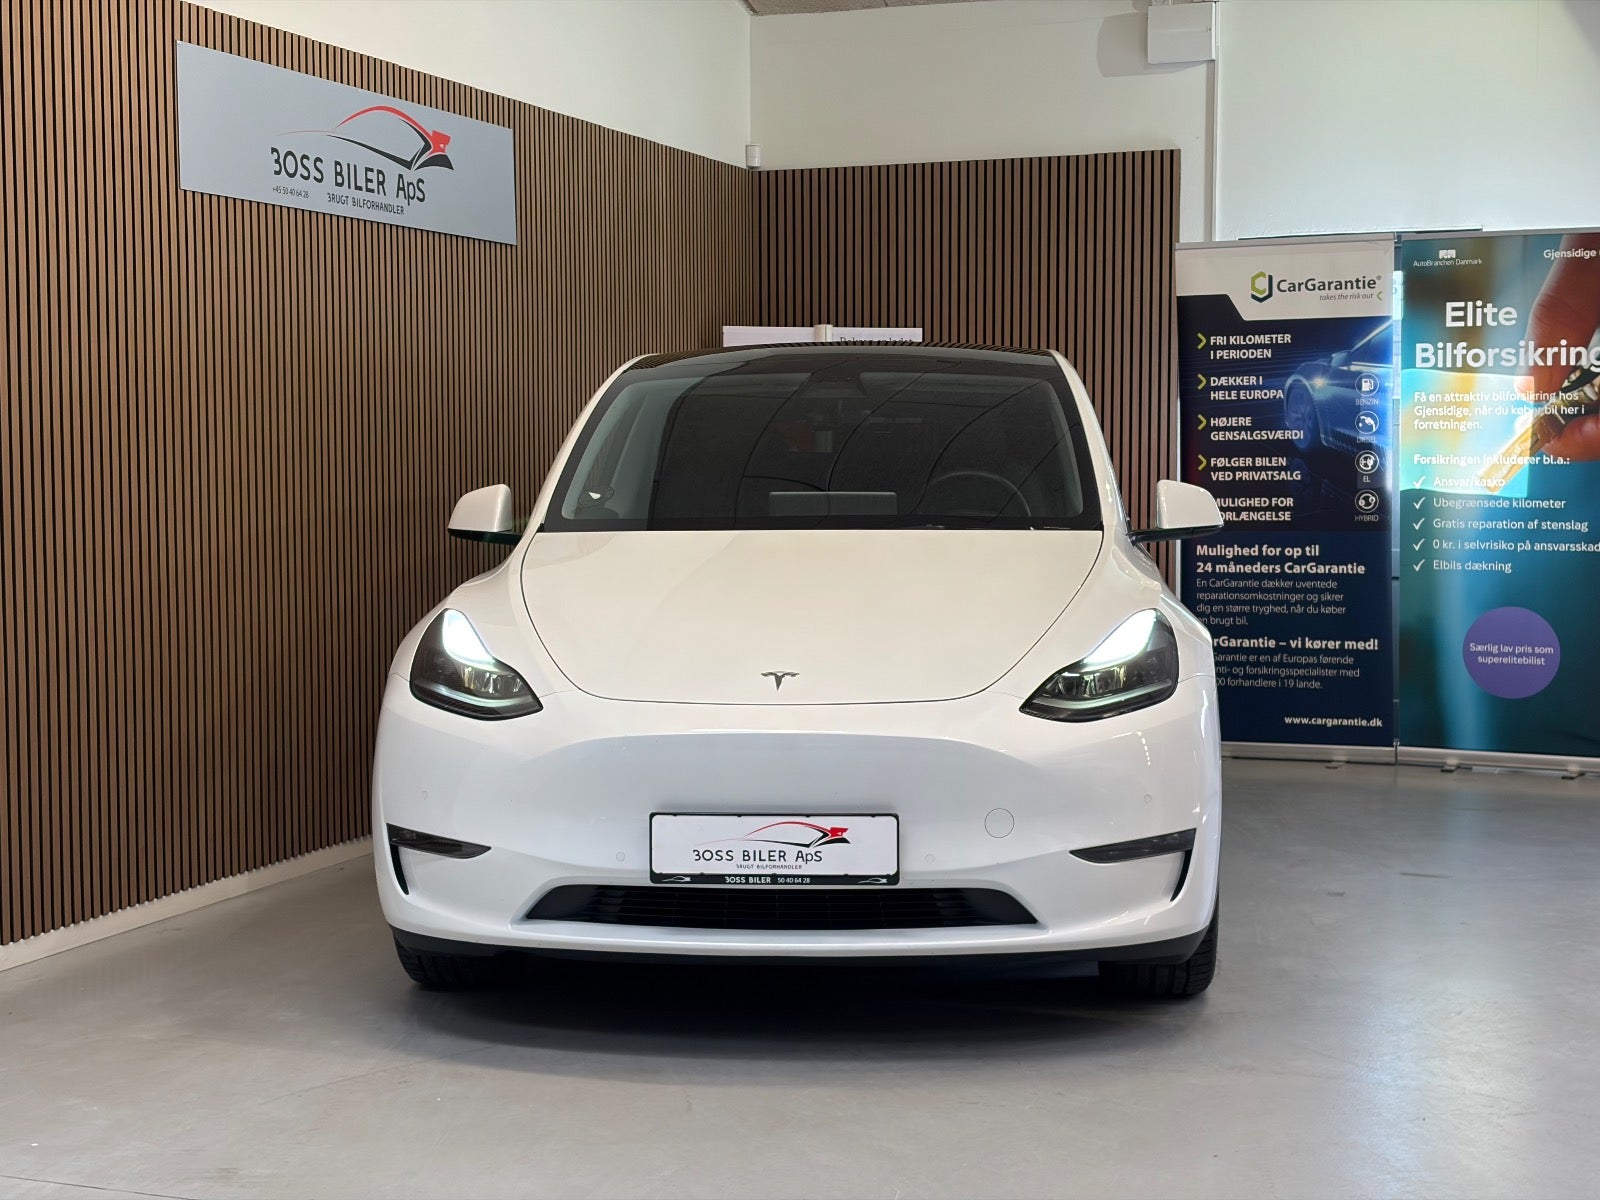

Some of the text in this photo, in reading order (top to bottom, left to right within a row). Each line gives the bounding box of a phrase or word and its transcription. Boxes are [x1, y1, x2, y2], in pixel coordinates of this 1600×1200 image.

[334, 160, 387, 196] BILER
[396, 173, 426, 206] ApS
[352, 197, 405, 215] BILFORHANDLER
[1543, 248, 1597, 260] Gjensidige
[1349, 292, 1361, 300] risk
[1445, 300, 1518, 328] Elite
[1210, 334, 1292, 346] FRI KILOMETER
[1216, 349, 1272, 360] PERIODEN
[1210, 376, 1257, 387] DÆKKER
[1210, 389, 1284, 401] HELE EUROPA
[1414, 391, 1426, 401] Få
[1444, 391, 1490, 401] attraktiv
[1492, 390, 1556, 402] bilforsikring
[1559, 391, 1579, 400] hos
[1414, 405, 1472, 418] Gjensidige,
[1475, 405, 1492, 415] når
[1495, 405, 1508, 415] du
[1544, 405, 1557, 415] bil
[1560, 405, 1580, 415] her
[1210, 417, 1252, 428] HØJERE
[1414, 419, 1483, 431] forretningen.
[1210, 430, 1304, 441] GENSALGSVÆRDI
[1210, 457, 1287, 468] FØLGER BILEN
[1414, 454, 1481, 465] Forsikringen
[1483, 454, 1540, 464] inkluderer
[1210, 471, 1301, 481] VED PRIVATSALG
[1363, 475, 1371, 483] EL
[1433, 476, 1505, 488] Ansvar/kasko
[1272, 498, 1294, 507] FOR
[1433, 497, 1566, 510] Ubegrænsede kilometer
[1220, 511, 1292, 521] RLÆNGELSE
[1355, 514, 1379, 522] HYBRID
[1433, 518, 1589, 532] Gratis reparation af stenslag
[1196, 544, 1320, 559] Mulighed for op til
[1432, 539, 1440, 549] 0
[1442, 539, 1456, 549] kr.
[1464, 540, 1514, 550] selvrisiko
[1517, 540, 1531, 552] på
[1534, 541, 1600, 552] ansvarsskad
[1196, 562, 1366, 575] 24 måneders CarGarantie
[1433, 559, 1512, 573] Elbils dækning
[1196, 579, 1338, 589] En CarGarantie dækker uventede
[1196, 591, 1344, 602] reparationsomkostninger og sikrer
[1196, 603, 1346, 615] dig en større tryghed, når du køber
[1210, 616, 1234, 626] brugt
[1213, 636, 1276, 648] rGarantie
[1290, 637, 1302, 648] vi
[1305, 637, 1341, 649] kører
[1344, 638, 1378, 650] med!
[1469, 642, 1554, 654] Særlig lav pris som
[1260, 655, 1270, 663] en
[1272, 653, 1282, 663] af
[1283, 654, 1318, 664] Europas
[1319, 655, 1354, 664] førende
[1477, 655, 1546, 665] superelitebilist
[1232, 667, 1244, 675] og
[1246, 665, 1338, 677] forsikringsspecialister
[1339, 668, 1360, 678] med
[1227, 678, 1277, 687] forhandlere
[1283, 680, 1294, 688] 19
[1296, 680, 1323, 689] lande.
[1284, 716, 1383, 727] www.cargarantie.dk
[742, 850, 787, 862] BILER
[795, 850, 823, 864] ApS
[749, 876, 771, 884] BILER
